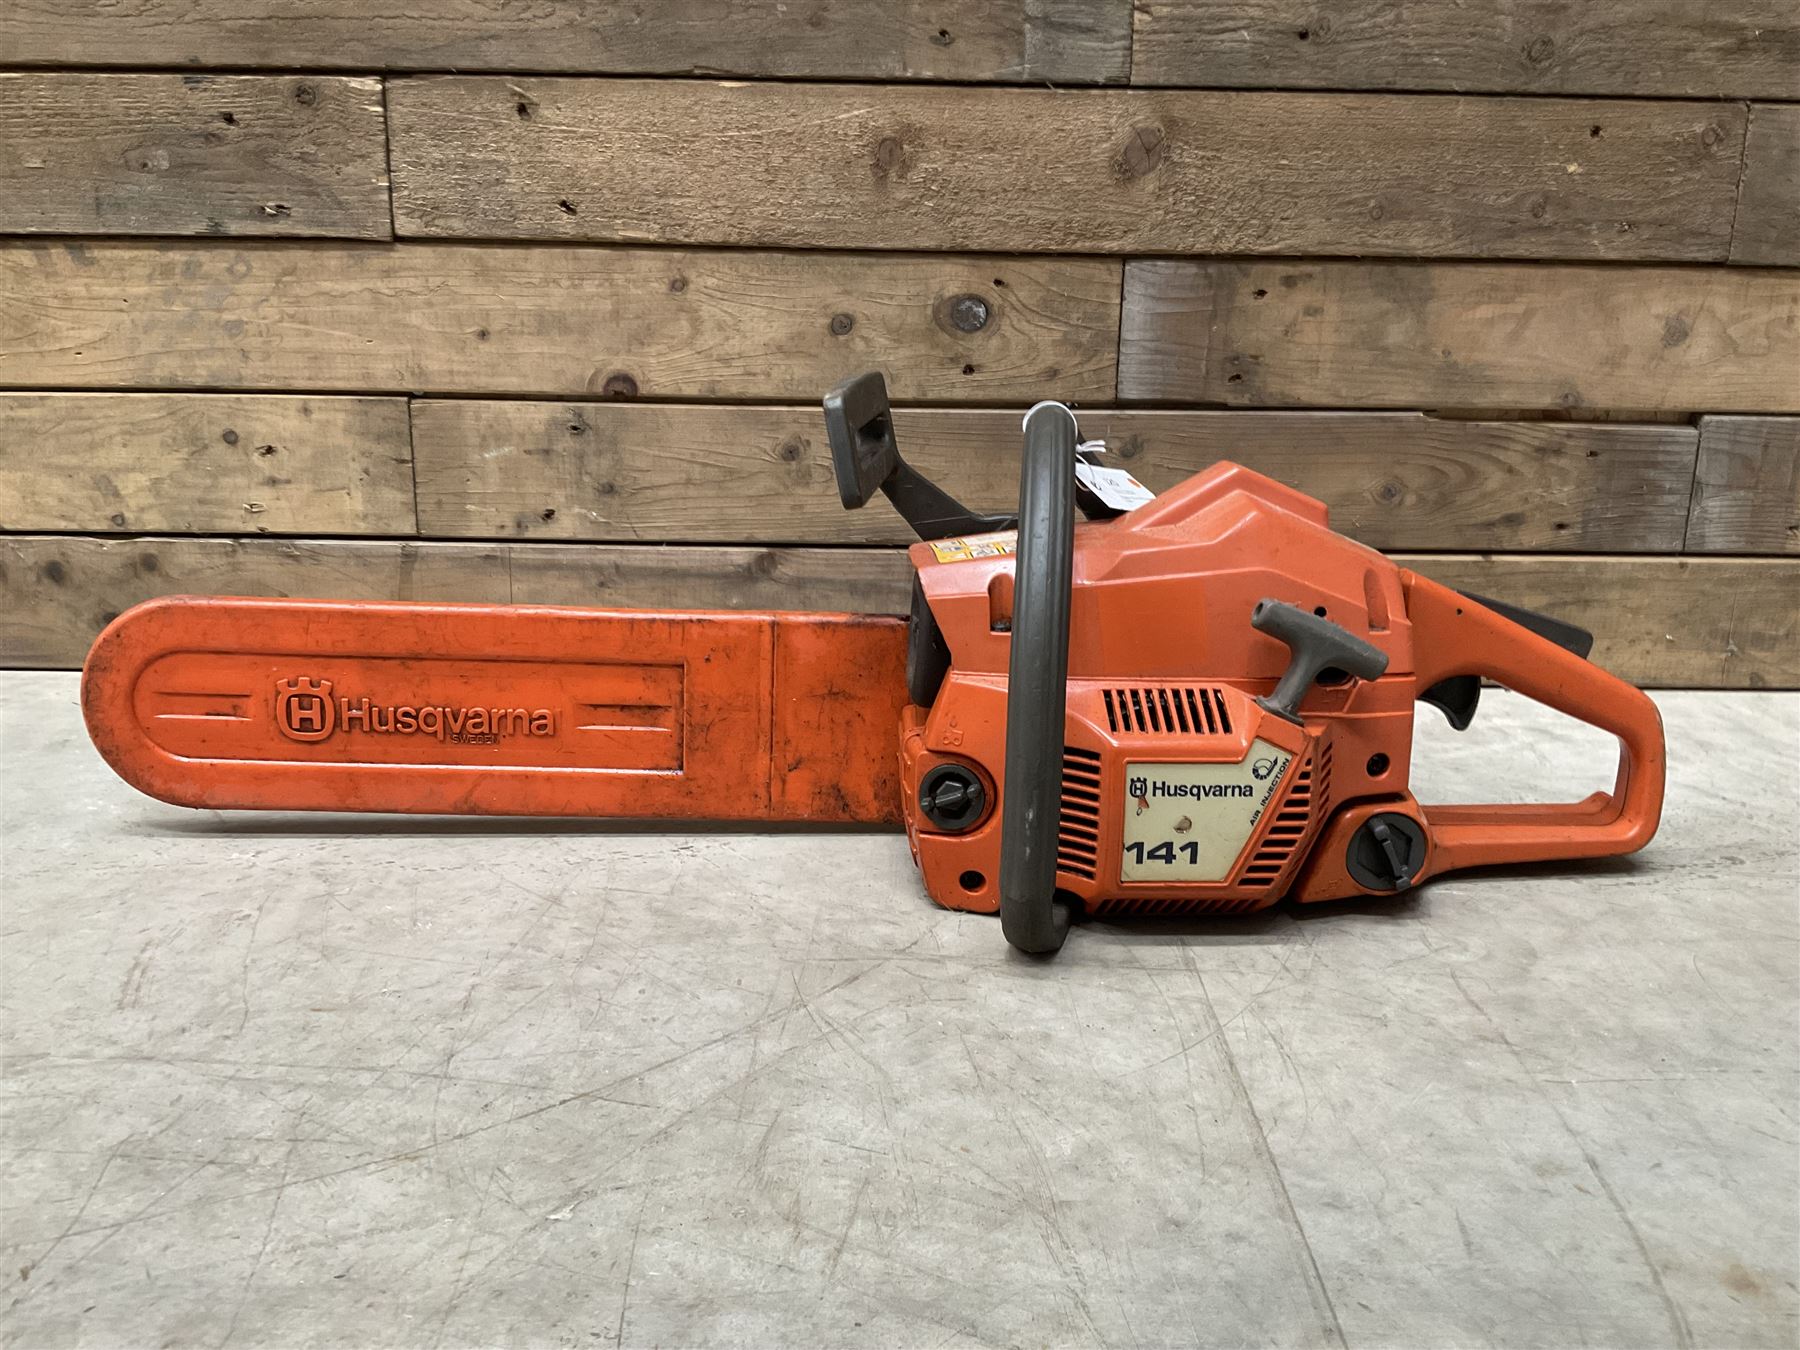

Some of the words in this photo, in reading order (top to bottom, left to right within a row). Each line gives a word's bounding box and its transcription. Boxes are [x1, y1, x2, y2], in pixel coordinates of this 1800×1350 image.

[341, 698, 556, 741] Husqvarna
[451, 734, 500, 745] SWEDEN
[1152, 781, 1254, 801] Husqvarna
[1249, 810, 1261, 826] AIR
[1260, 758, 1290, 807] INJECTION
[1125, 841, 1199, 864] 141
